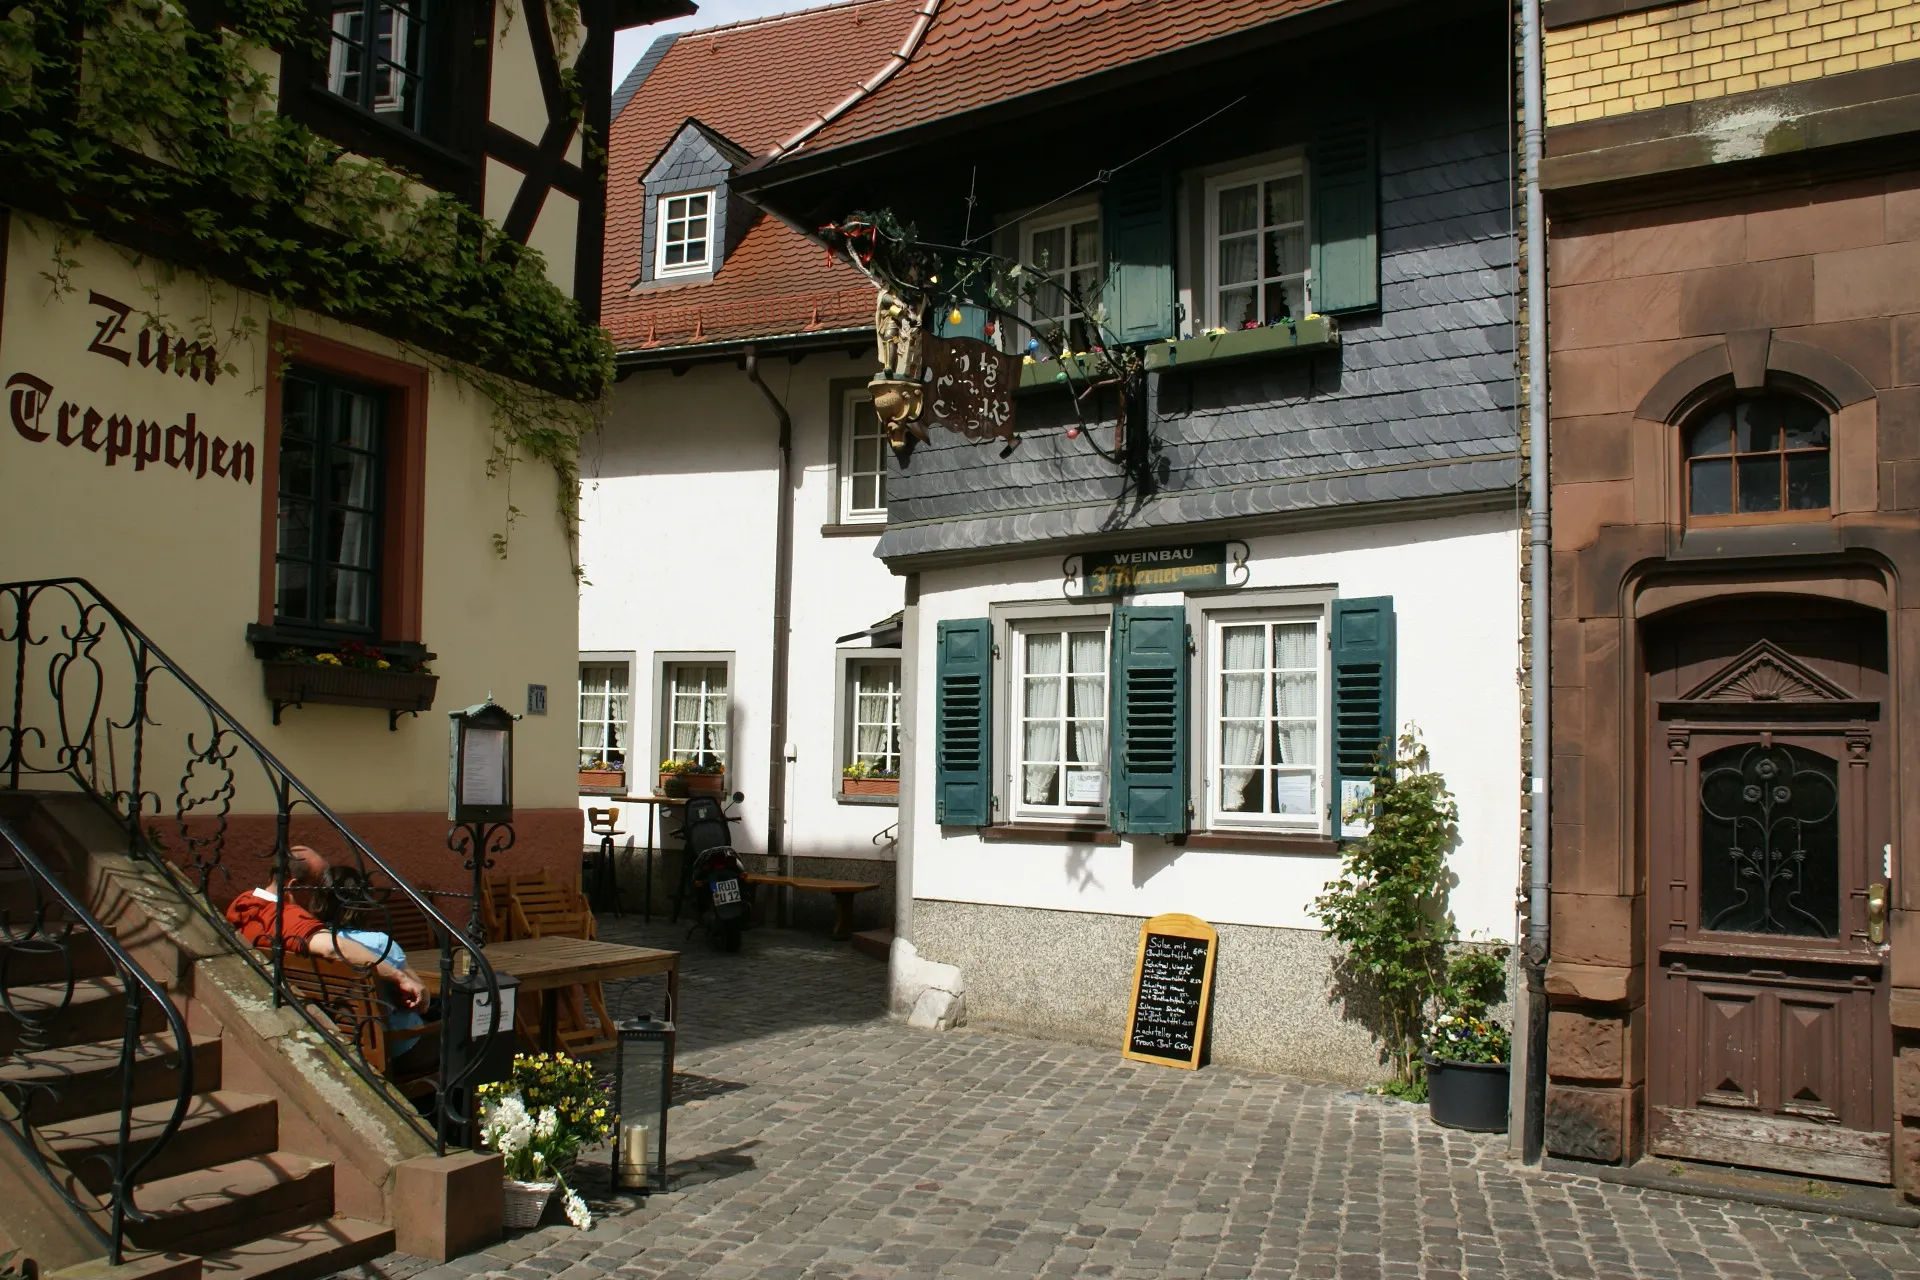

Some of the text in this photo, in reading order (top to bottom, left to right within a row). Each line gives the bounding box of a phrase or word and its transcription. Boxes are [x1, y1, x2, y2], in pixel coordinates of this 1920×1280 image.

[87, 288, 218, 386] Zum
[5, 371, 255, 486] Treppchen
[1113, 548, 1194, 564] WEINBAU
[1182, 563, 1218, 577] ERBEN
[718, 880, 737, 892] RÜD
[720, 890, 740, 903] U 12
[1174, 941, 1187, 950] mit
[1175, 1031, 1189, 1040] mit
